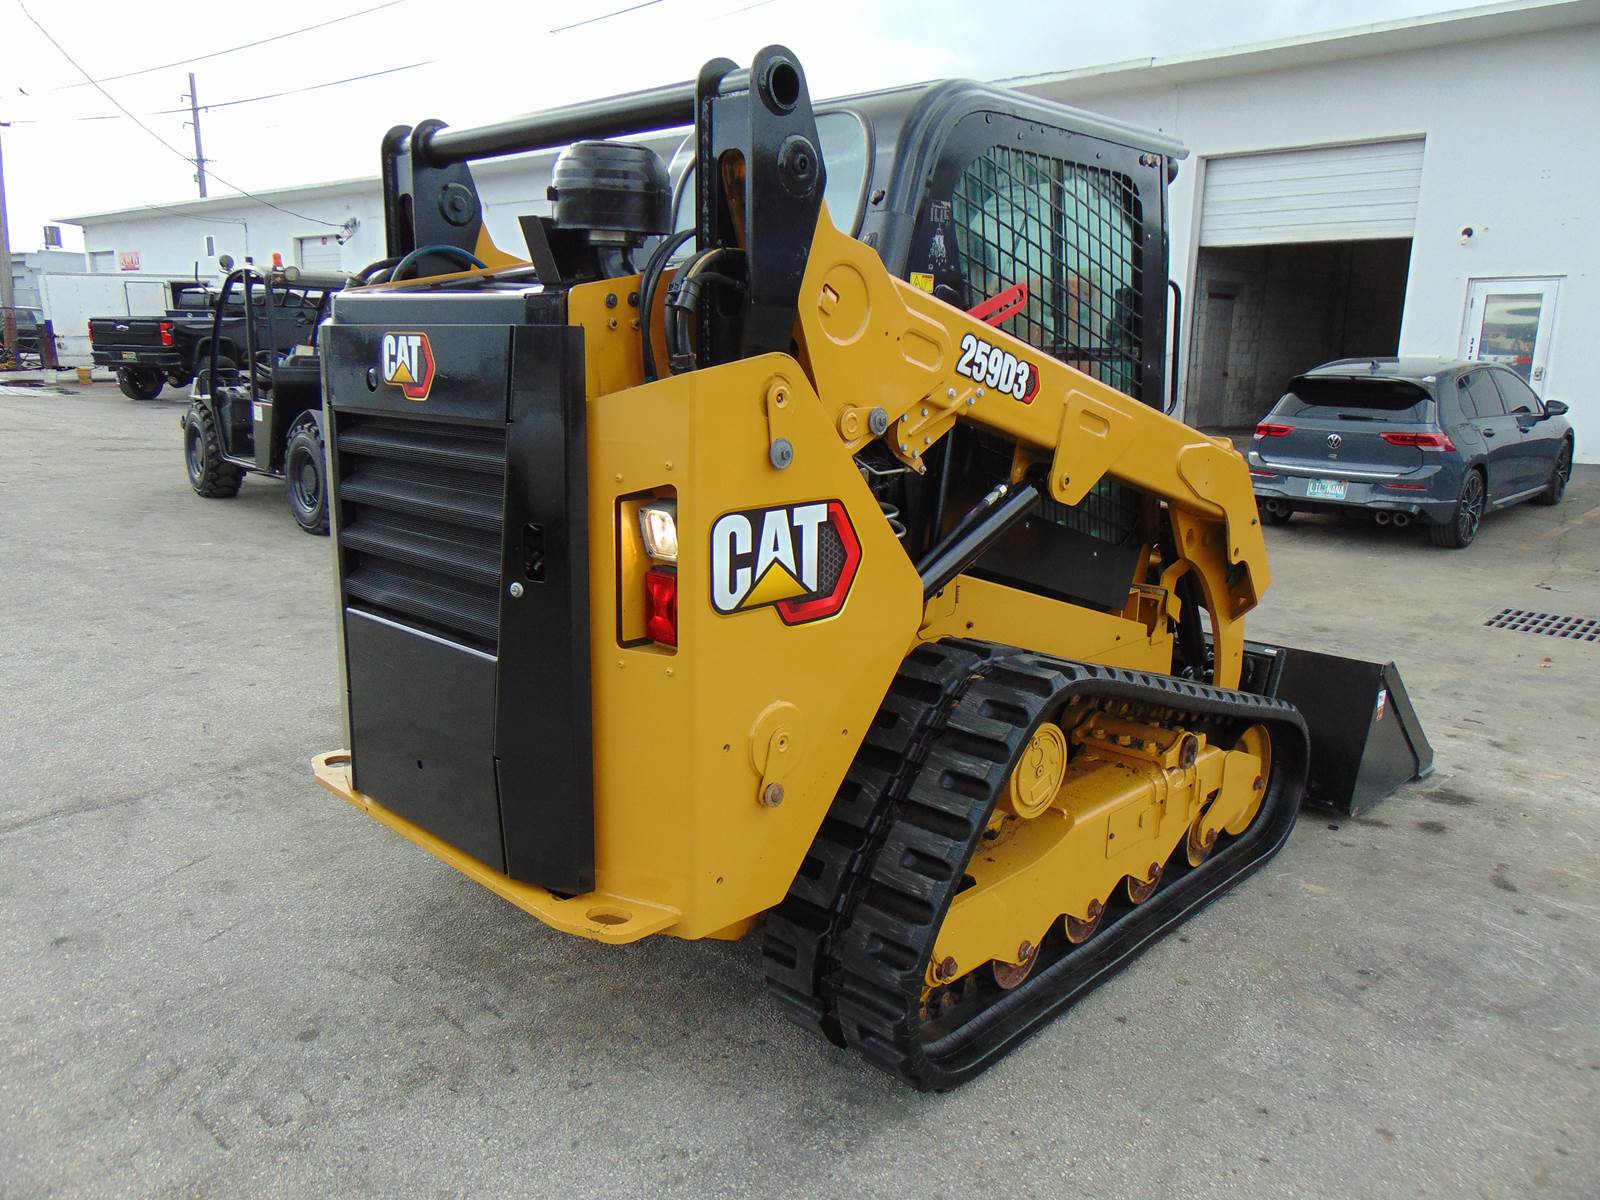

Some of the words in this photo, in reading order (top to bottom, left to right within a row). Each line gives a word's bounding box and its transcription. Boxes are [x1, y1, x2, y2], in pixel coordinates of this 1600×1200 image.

[384, 334, 421, 383] CAT
[956, 333, 1030, 401] 259D3
[713, 503, 828, 611] CAT
